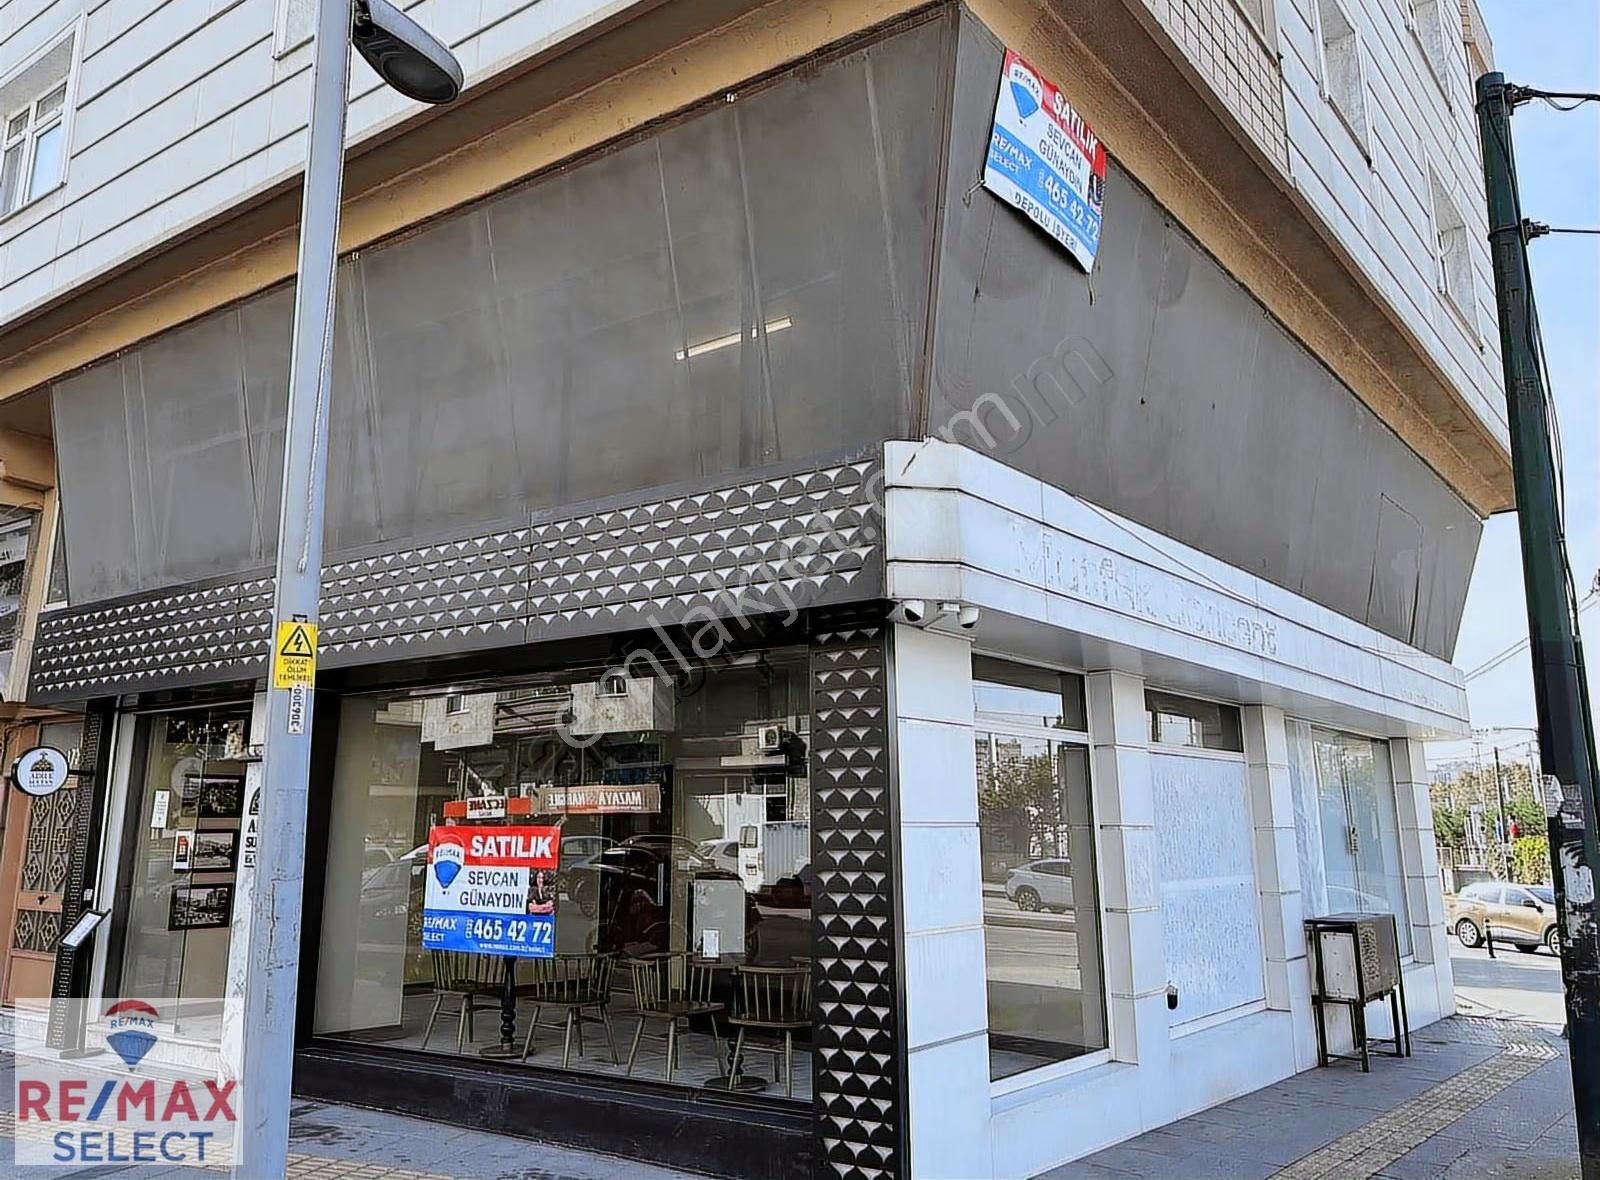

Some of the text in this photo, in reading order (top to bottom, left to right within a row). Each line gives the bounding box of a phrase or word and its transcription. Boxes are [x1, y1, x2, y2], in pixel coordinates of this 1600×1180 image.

[1053, 91, 1098, 160] SATILIK
[992, 133, 1033, 170] RE/MAX
[1046, 123, 1082, 170] SEVCAN
[1014, 192, 1051, 228] DEPOLU
[469, 835, 554, 859] SATILIK
[467, 870, 519, 887] SEVCAN
[459, 889, 524, 909] GÜNAYDIN
[473, 918, 503, 941] 465
[507, 920, 527, 942] 42
[532, 922, 552, 944] 72
